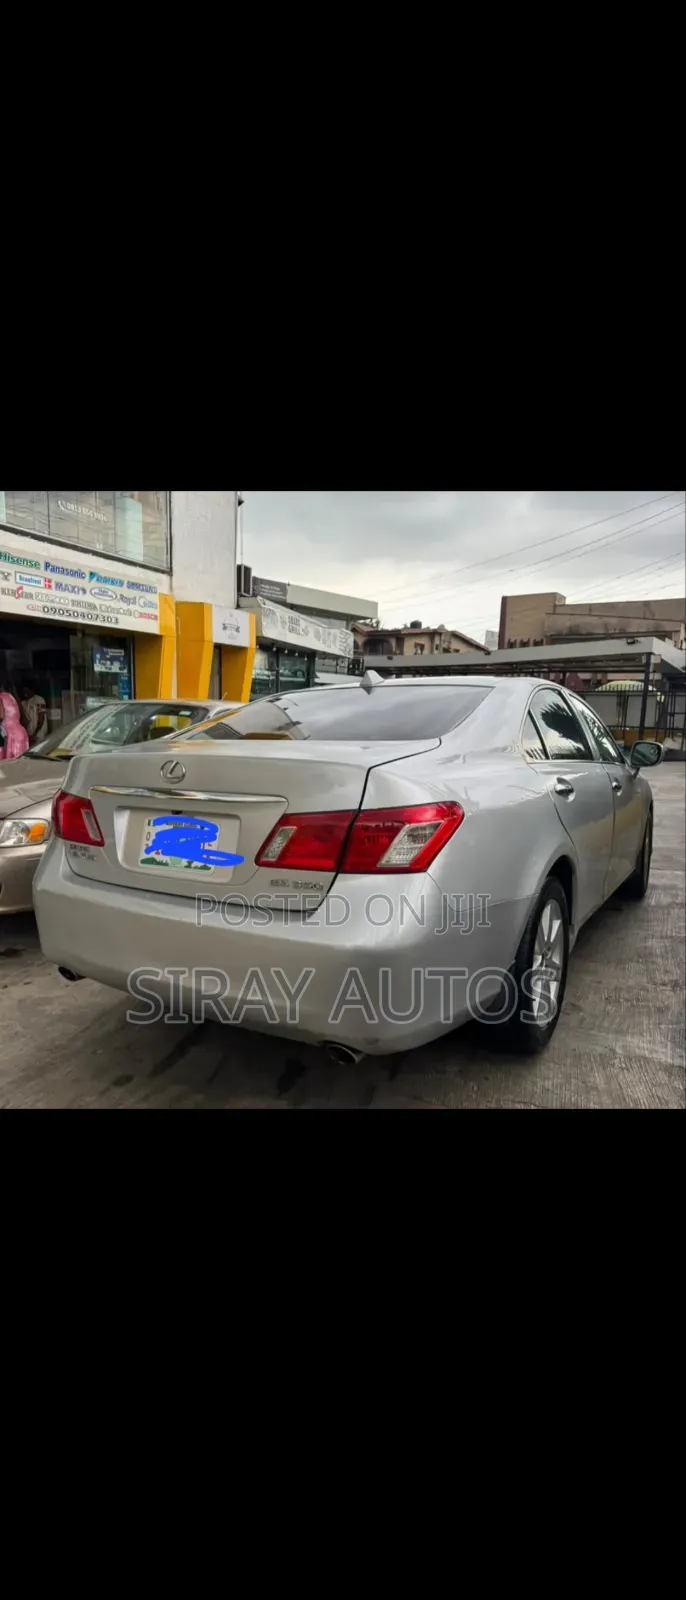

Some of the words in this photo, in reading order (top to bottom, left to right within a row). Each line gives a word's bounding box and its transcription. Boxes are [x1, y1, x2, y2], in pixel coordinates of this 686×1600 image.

[0, 552, 41, 569] Hisense
[44, 561, 86, 580] Panasonic
[127, 580, 157, 594] SAMSUNG
[55, 581, 80, 595] MAXI
[120, 594, 136, 606] Royal
[42, 605, 119, 625] 09050407303
